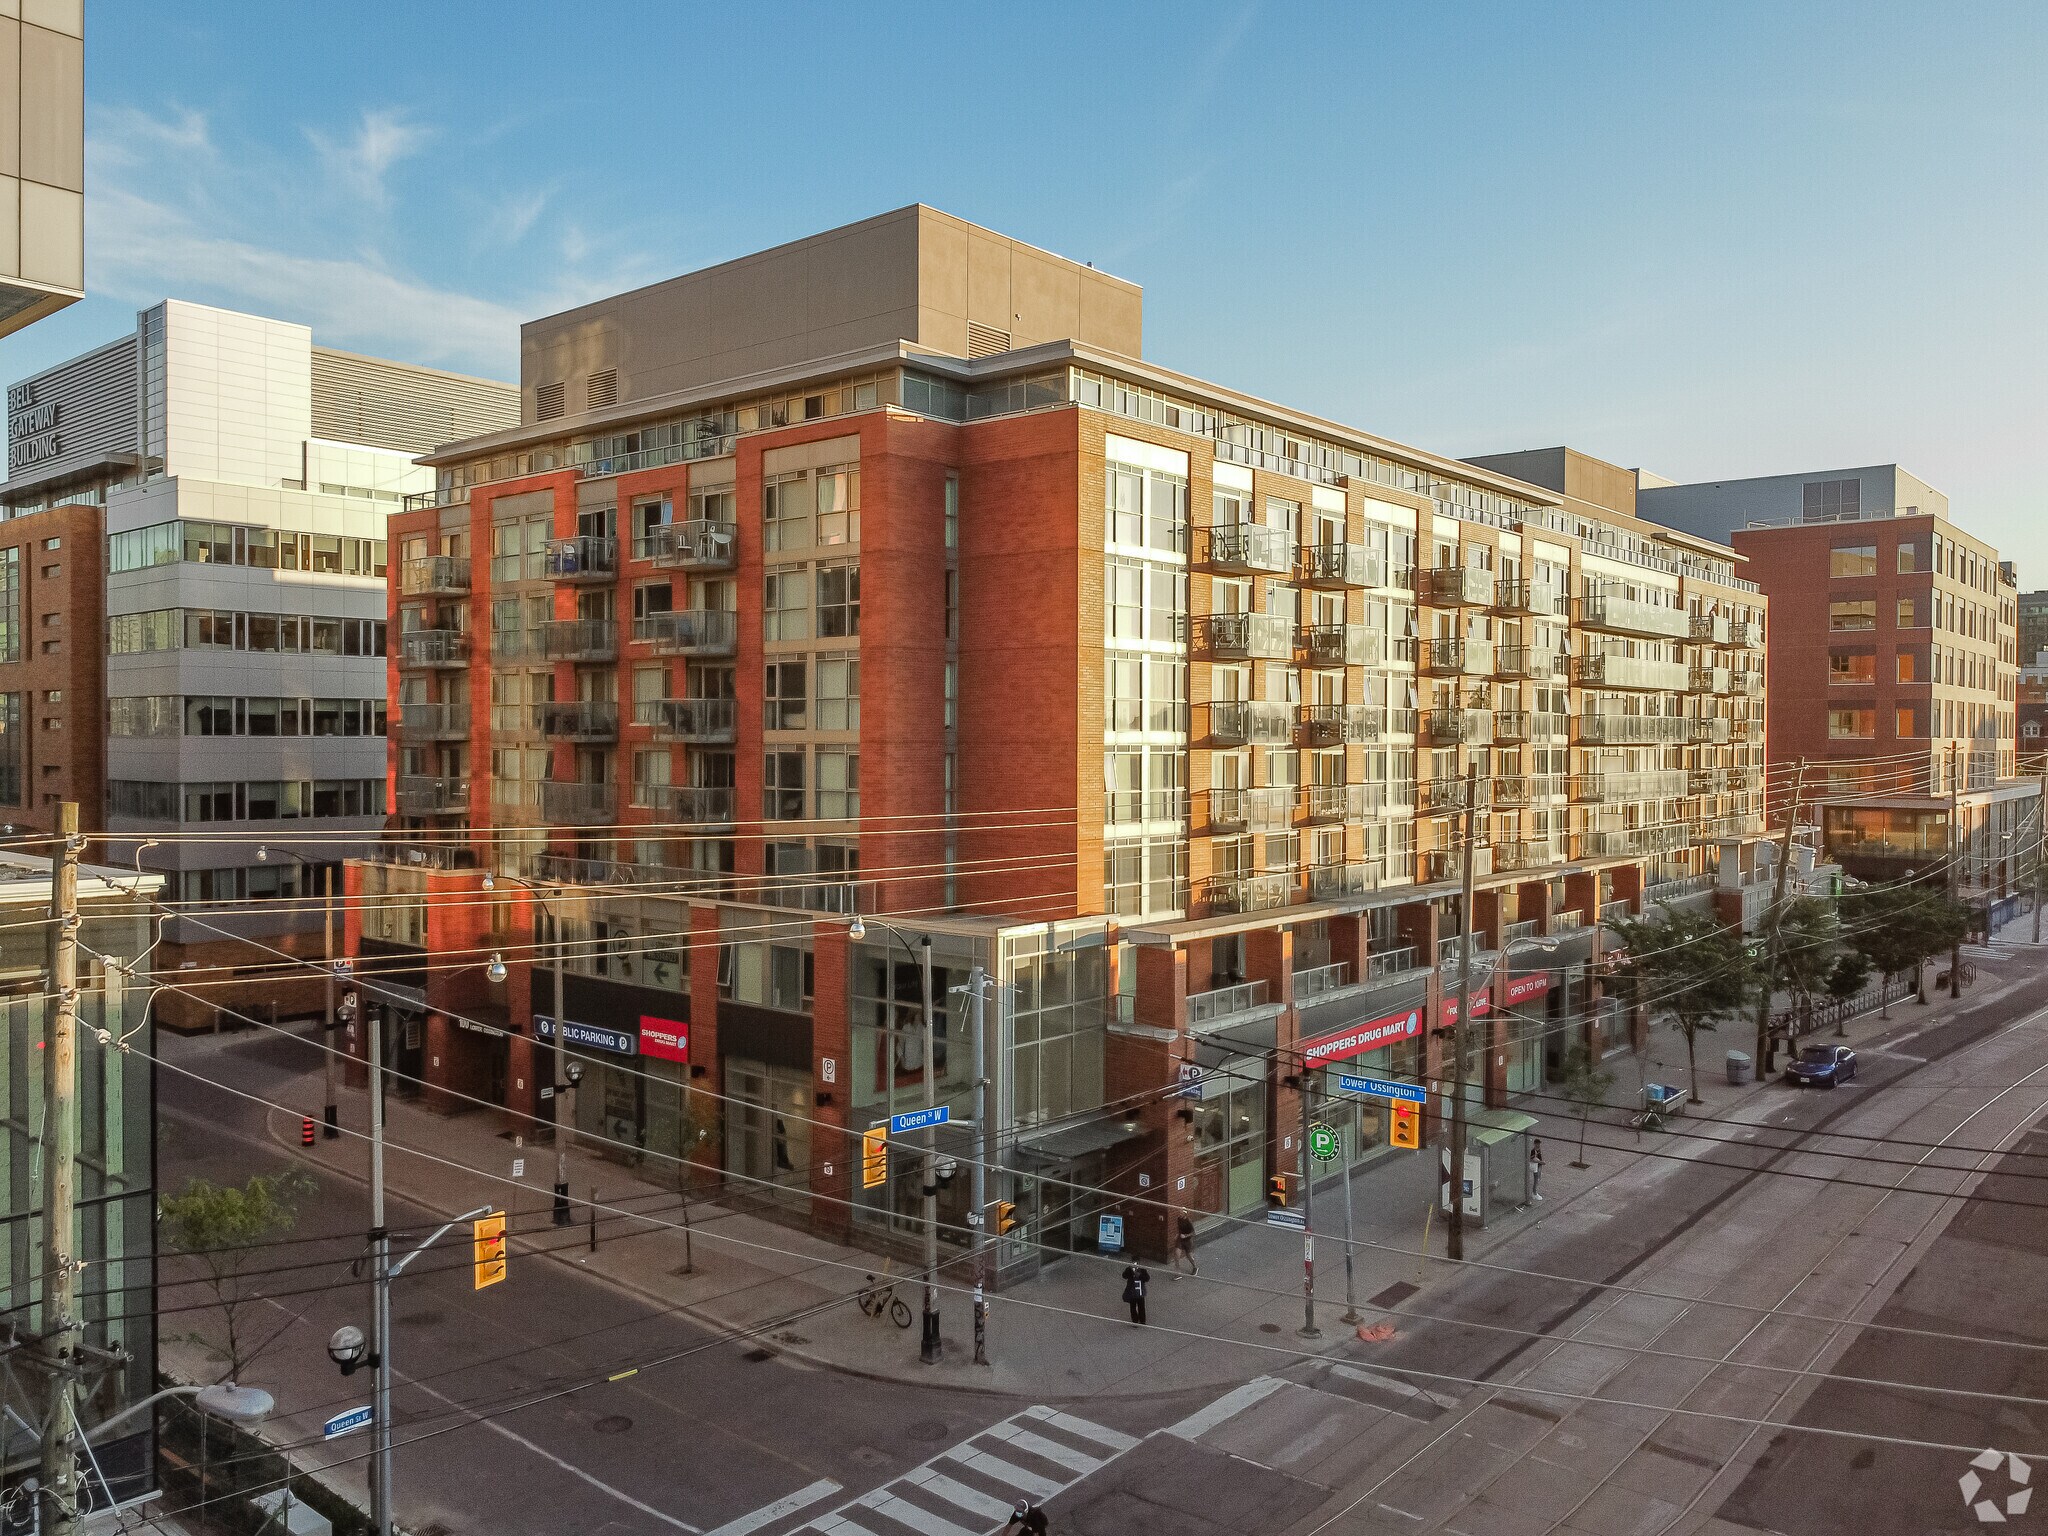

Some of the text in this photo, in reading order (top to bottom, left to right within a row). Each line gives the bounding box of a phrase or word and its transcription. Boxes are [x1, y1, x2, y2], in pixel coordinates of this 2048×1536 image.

[9, 384, 32, 411] BELL
[10, 404, 56, 439] GATEWAY
[10, 433, 57, 467] BUILDING
[1510, 985, 1526, 997] OPEN
[1526, 982, 1533, 992] TO
[552, 1024, 580, 1039] PBLIC
[580, 1030, 615, 1046] PARKING
[641, 1029, 677, 1042] SHOPPERS
[1306, 1021, 1406, 1061] SHOPPERS DRUG MART
[1340, 1076, 1367, 1090] Lower
[1370, 1082, 1416, 1098] Ossington
[899, 1114, 927, 1128] Queen
[934, 1109, 942, 1121] W
[1316, 1133, 1329, 1148] P
[331, 1417, 354, 1432] Queen
[362, 1411, 369, 1420] W
